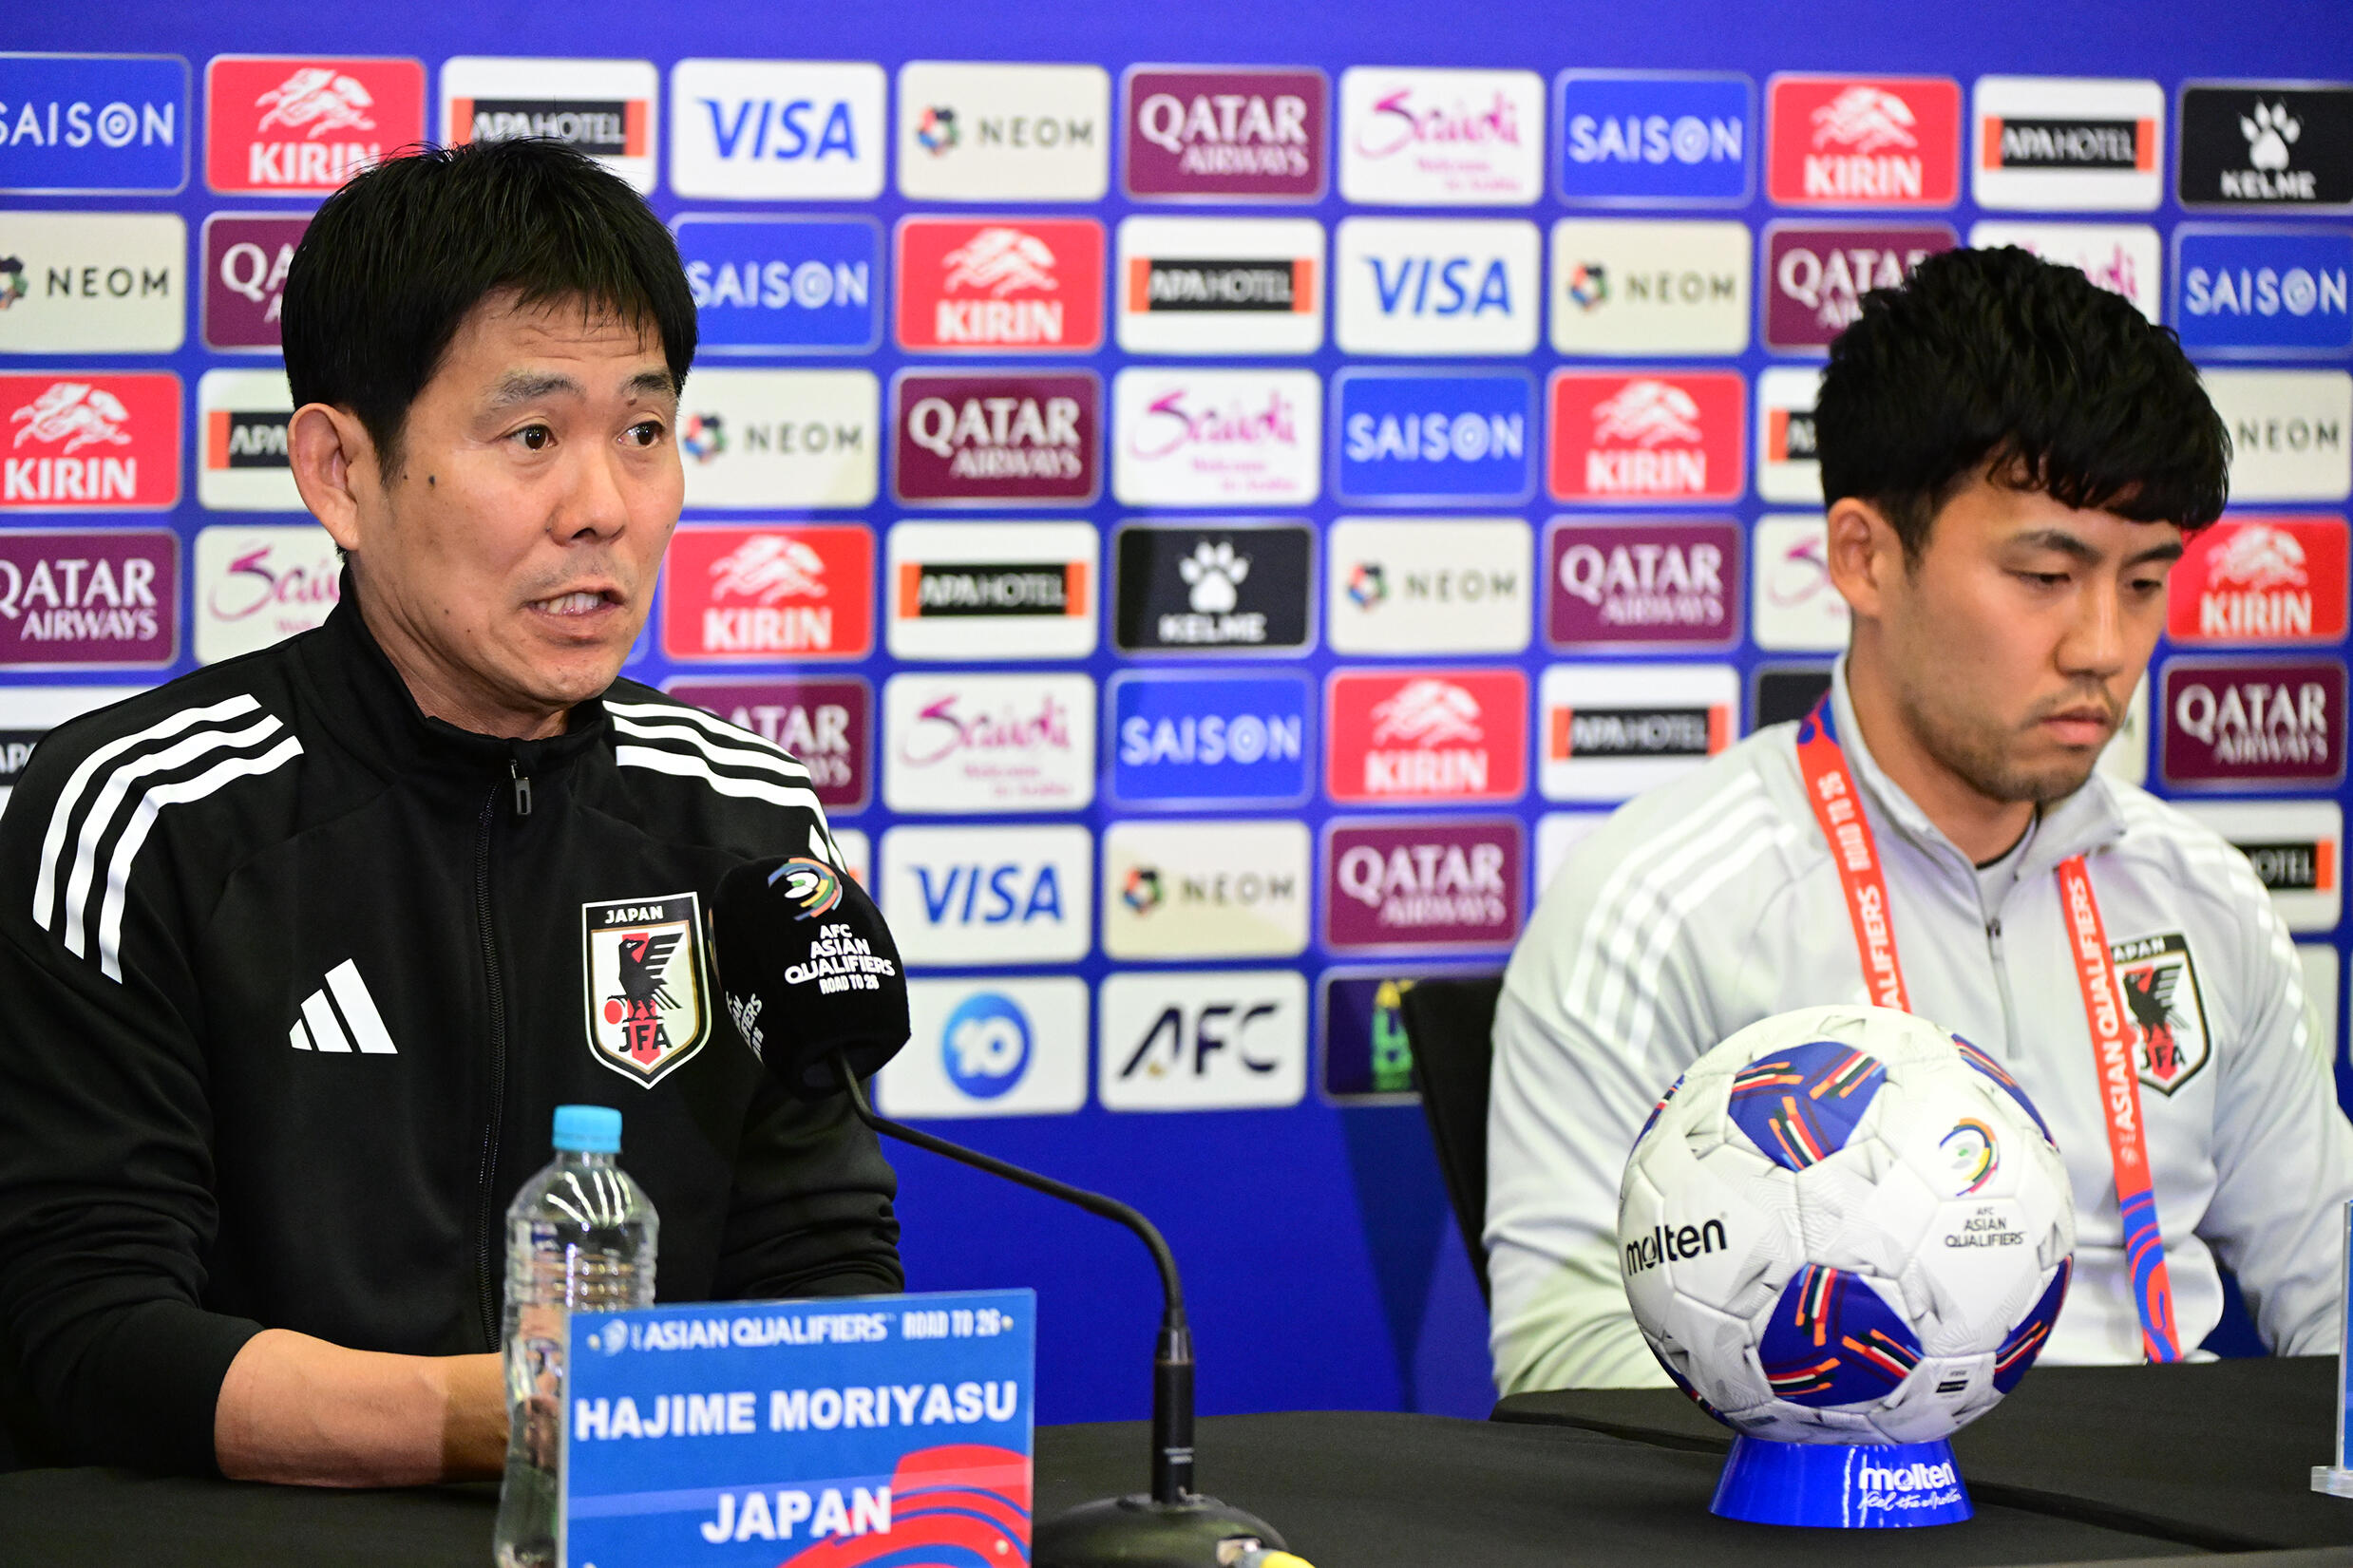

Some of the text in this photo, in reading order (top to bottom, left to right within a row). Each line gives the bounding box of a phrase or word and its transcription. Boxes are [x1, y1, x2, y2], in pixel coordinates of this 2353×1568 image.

[701, 98, 859, 160] VISA
[977, 117, 1094, 147] NEOM
[1140, 93, 1308, 154] QATAR
[1568, 115, 1743, 164] SAISON
[1181, 145, 1309, 176] AIRWAYS
[1805, 156, 1923, 198] KIRIN
[2220, 170, 2317, 198] KELME
[47, 266, 169, 298] NEOM
[684, 261, 869, 310] SAISON
[1363, 257, 1513, 317] VISA
[1625, 273, 1736, 304] NEOM
[2185, 267, 2347, 316] SAISON
[936, 300, 1064, 342] KIRIN
[744, 422, 863, 453] NEOM
[908, 398, 1080, 458] QATAR
[1346, 411, 1524, 463] SAISON
[2236, 419, 2340, 451] NEOM
[4, 457, 137, 500] KIRIN
[950, 448, 1082, 480] AIRWAYS
[1585, 448, 1707, 492] KIRIN
[1405, 572, 1516, 600] NEOM
[1559, 543, 1723, 606] QATAR
[21, 609, 159, 642] AIRWAYS
[703, 607, 832, 650] KIRIN
[1158, 614, 1267, 643] KELME
[1600, 595, 1724, 627] AIRWAYS
[2199, 590, 2312, 636] KIRIN
[2175, 682, 2329, 746] QATAR
[1121, 714, 1301, 765] SAISON
[2213, 733, 2329, 764] AIRWAYS
[1365, 749, 1489, 792] KIRIN
[907, 866, 1064, 924] VISA
[1179, 875, 1295, 905] NEOM
[1338, 843, 1506, 907] QATAR
[604, 905, 664, 924] JAPAN
[820, 923, 853, 939] AFC
[1380, 894, 1507, 927] AIRWAYS
[810, 938, 871, 958] ASIAN
[2067, 876, 2120, 1039] QUALIFIERS
[2112, 936, 2166, 963] APAN
[784, 955, 896, 985] QUALIFIERS
[819, 974, 880, 995] ROAD TO 26
[618, 1024, 673, 1052] JFA
[953, 1016, 1025, 1077] 10
[1119, 999, 1282, 1079] AFC
[2102, 1040, 2136, 1132] ASIAN
[1945, 1232, 2025, 1248] QUALIFIERS
[1964, 1218, 2006, 1232] ASIAN
[1626, 1219, 1727, 1276] molten
[643, 1318, 730, 1351] ASIAN
[731, 1313, 888, 1348] QUALIFIERS
[901, 1311, 949, 1340] ROAD
[951, 1309, 975, 1338] TO
[975, 1308, 1001, 1337] 26
[575, 1381, 1018, 1441] HAJIME MORIYASU
[1858, 1463, 1956, 1491] molten
[700, 1486, 892, 1543] JAPAN
